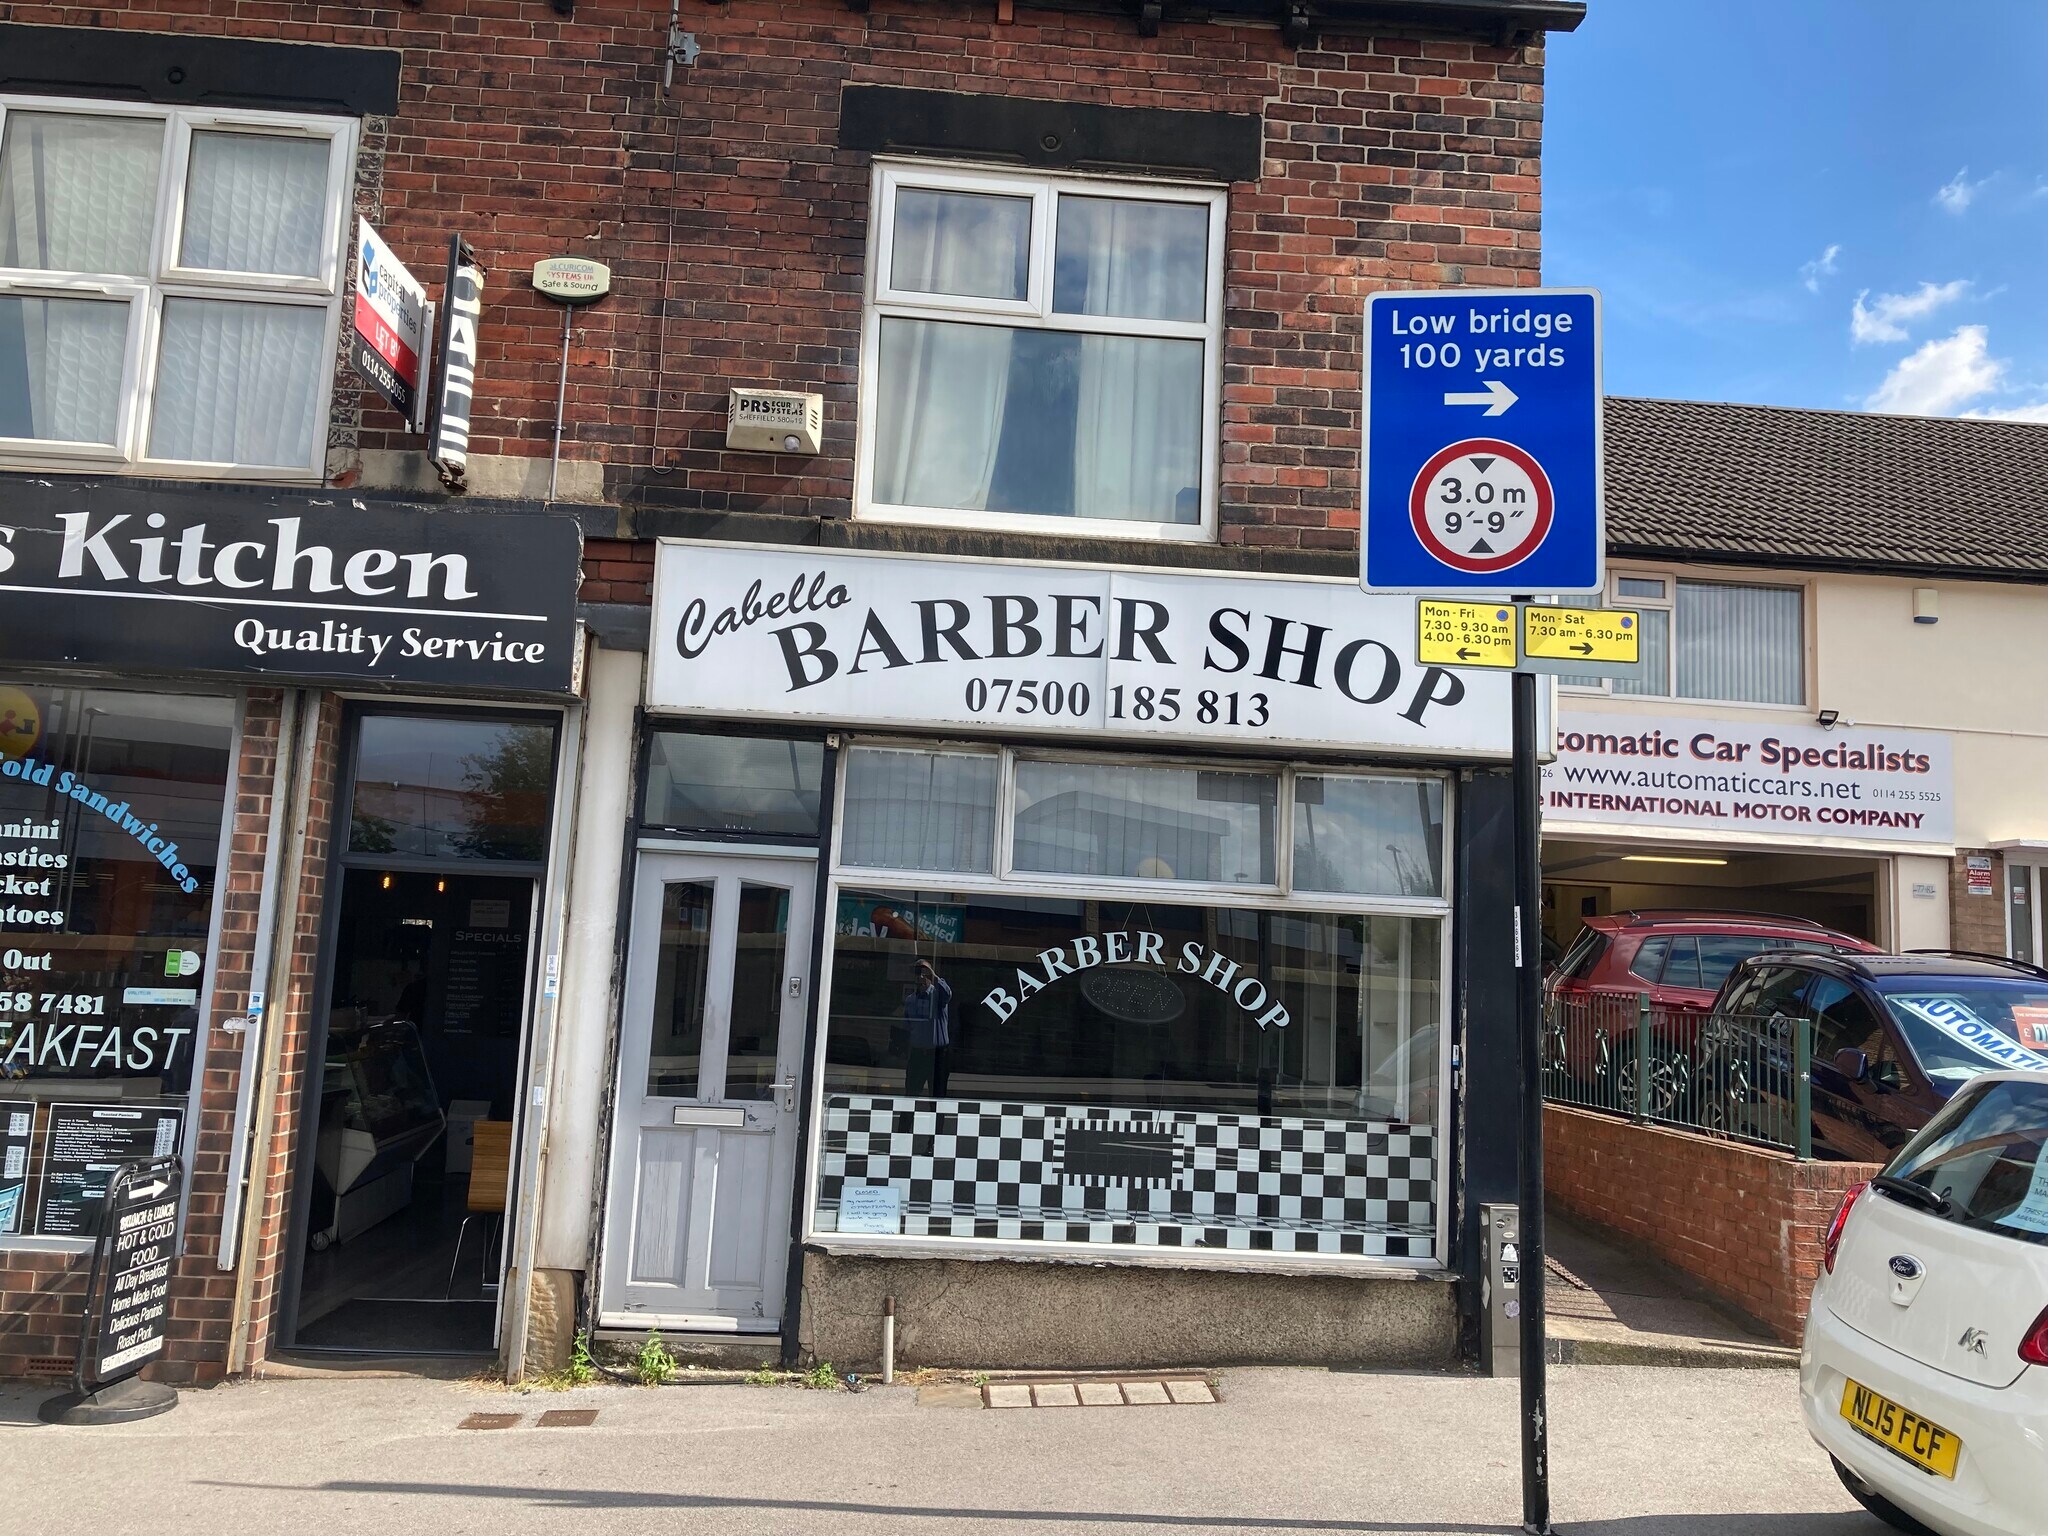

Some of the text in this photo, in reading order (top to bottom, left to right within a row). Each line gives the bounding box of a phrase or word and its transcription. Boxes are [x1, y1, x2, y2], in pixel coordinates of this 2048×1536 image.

[380, 264, 405, 303] capital
[542, 280, 561, 288] Safe
[570, 282, 598, 291] Sound
[378, 282, 417, 334] properties
[1392, 308, 1573, 338] Low bridge
[376, 322, 400, 361] LET BY
[362, 350, 378, 378] 0114
[378, 366, 391, 390] 255
[1400, 343, 1565, 373] 100 yards
[739, 413, 775, 422] SHEFFIELD
[1440, 478, 1526, 504] 3.0 m
[55, 511, 478, 601] Kitchen
[676, 570, 852, 660] Cabello
[1424, 620, 1452, 631] 7.30
[1460, 622, 1489, 633] 9.30
[1491, 625, 1509, 634] am
[1425, 608, 1452, 618] Mon
[1460, 608, 1475, 619] Fri
[1530, 613, 1555, 624] Mon
[1564, 614, 1585, 625] Sat
[233, 618, 545, 667] Quality Service
[1424, 632, 1454, 644] 4.00
[1463, 634, 1492, 646] 6.30
[1494, 638, 1512, 648] pm
[1530, 626, 1557, 637] 7.30
[1559, 630, 1576, 638] am
[1585, 628, 1613, 640] 6.30
[1616, 632, 1633, 642] pm
[768, 594, 1466, 729] BARBER SHOP
[965, 676, 1270, 728] 07500 185 813
[1690, 733, 1750, 762] Car
[1760, 738, 1931, 774] Specialists
[1564, 766, 1861, 800] www.automaticcars.net
[1872, 789, 1896, 798] 0114
[1898, 790, 1916, 800] 255
[1919, 792, 1941, 802] 5525
[0, 752, 199, 894] old Sandwiches
[1550, 791, 1727, 819] INTERNATIONAL
[1734, 804, 1812, 823] MOTOR
[1816, 806, 1925, 830] COMPANY
[0, 818, 60, 840] nini
[0, 846, 68, 868] sties
[0, 904, 64, 926] toes
[3, 949, 52, 972] Out
[980, 930, 1290, 1031] BARBER SHOP
[1090, 975, 1174, 1011] OPEN
[40, 993, 104, 1015] 7481
[116, 1221, 174, 1252] HOT & COLD
[130, 1246, 158, 1267] FOOD
[1892, 1259, 1914, 1273] Ford
[114, 1262, 168, 1293] All Day Breakfast
[110, 1281, 167, 1314] Home Made Food
[109, 1313, 140, 1334] Delicious
[117, 1325, 154, 1351] Roast Pork
[1852, 1386, 1946, 1460] NL15 FCF
